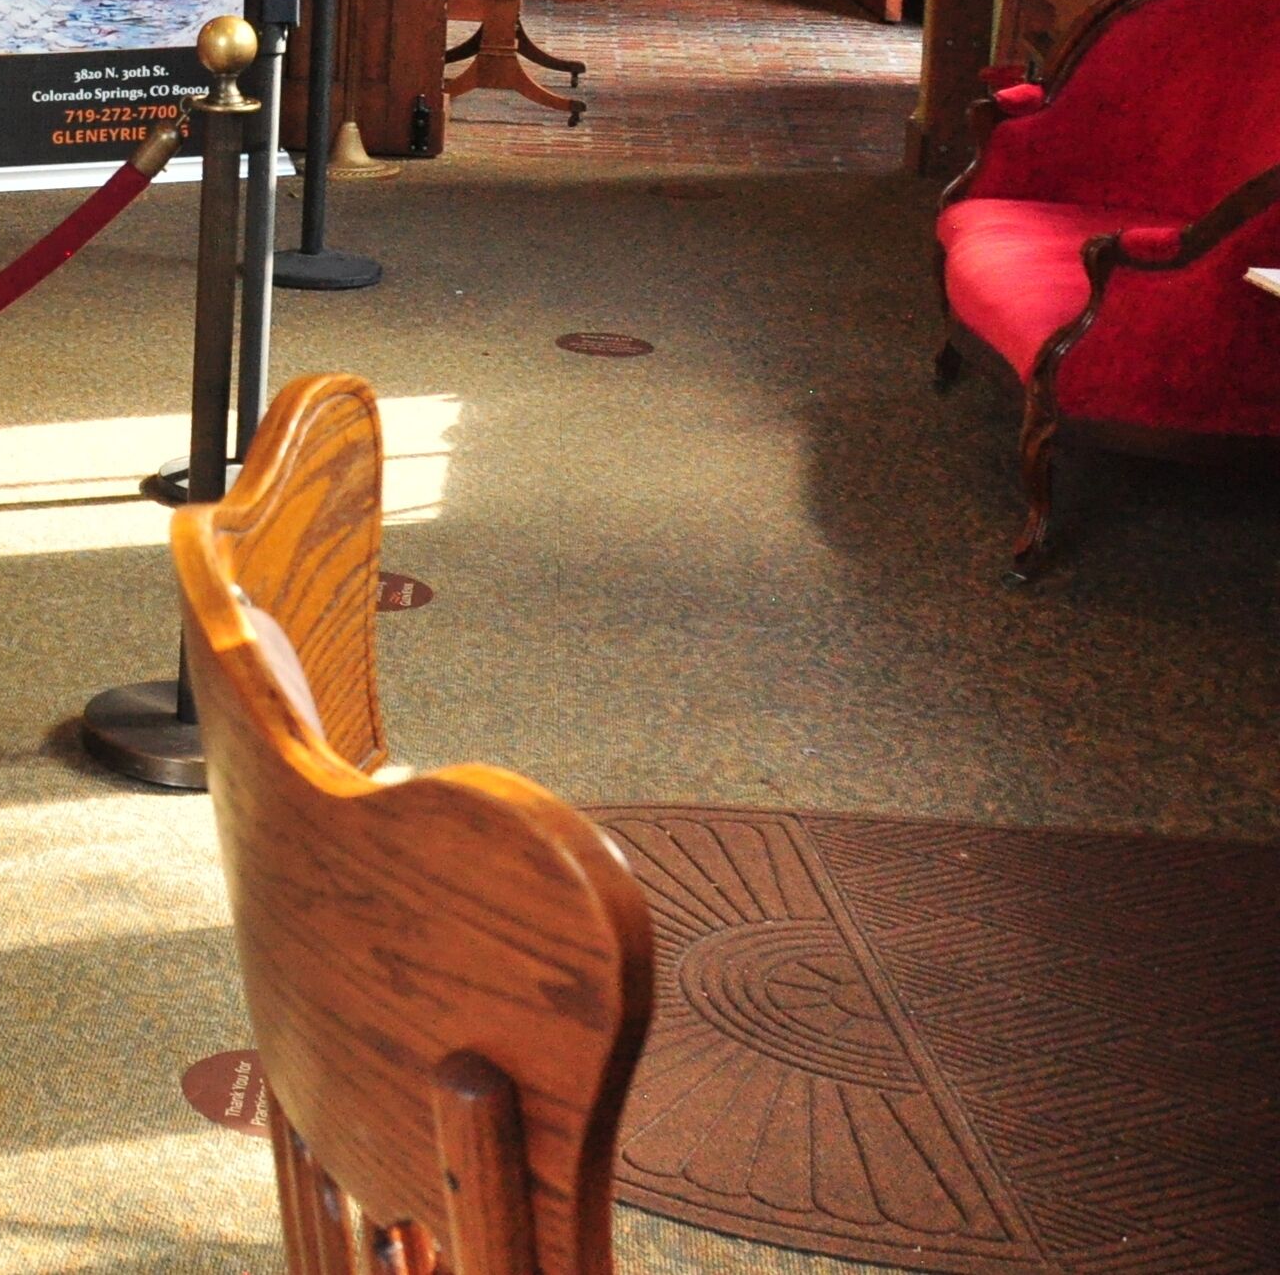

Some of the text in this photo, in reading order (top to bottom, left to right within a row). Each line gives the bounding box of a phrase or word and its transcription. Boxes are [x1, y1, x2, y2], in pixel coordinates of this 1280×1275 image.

[73, 65, 170, 84] 3820 N. 30th St.
[31, 88, 93, 103] Colorado
[94, 86, 147, 103] Springs,
[149, 84, 170, 97] CO
[64, 104, 178, 124] 719-272-7700
[224, 1060, 252, 1117] Thank You for
